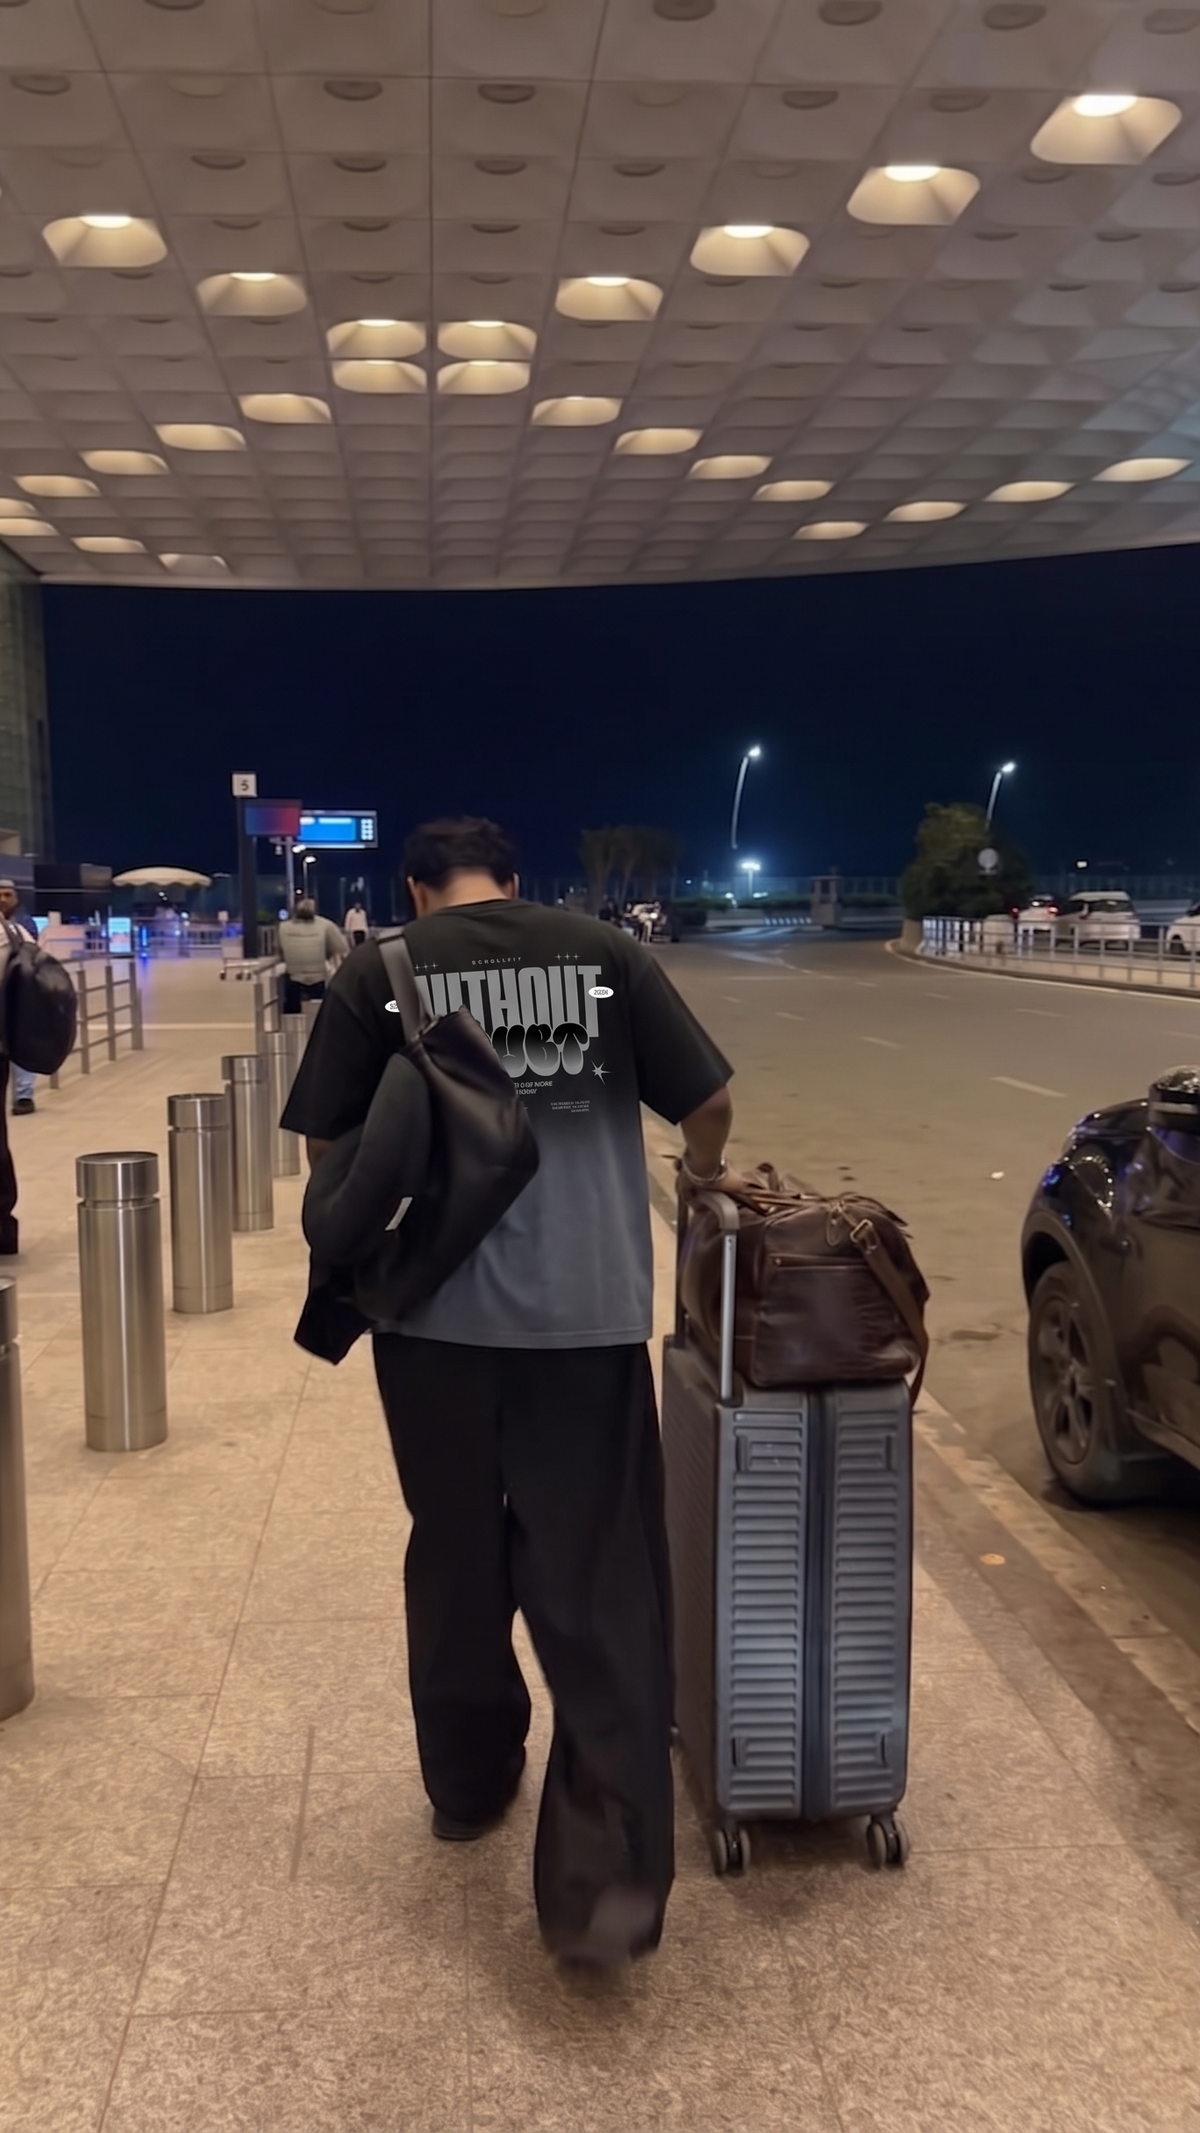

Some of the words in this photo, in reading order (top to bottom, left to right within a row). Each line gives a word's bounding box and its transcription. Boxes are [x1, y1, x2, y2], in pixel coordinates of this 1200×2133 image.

[240, 779, 250, 791] 5
[471, 956, 522, 966] SCROLLFIT
[490, 1021, 591, 1079] UBT
